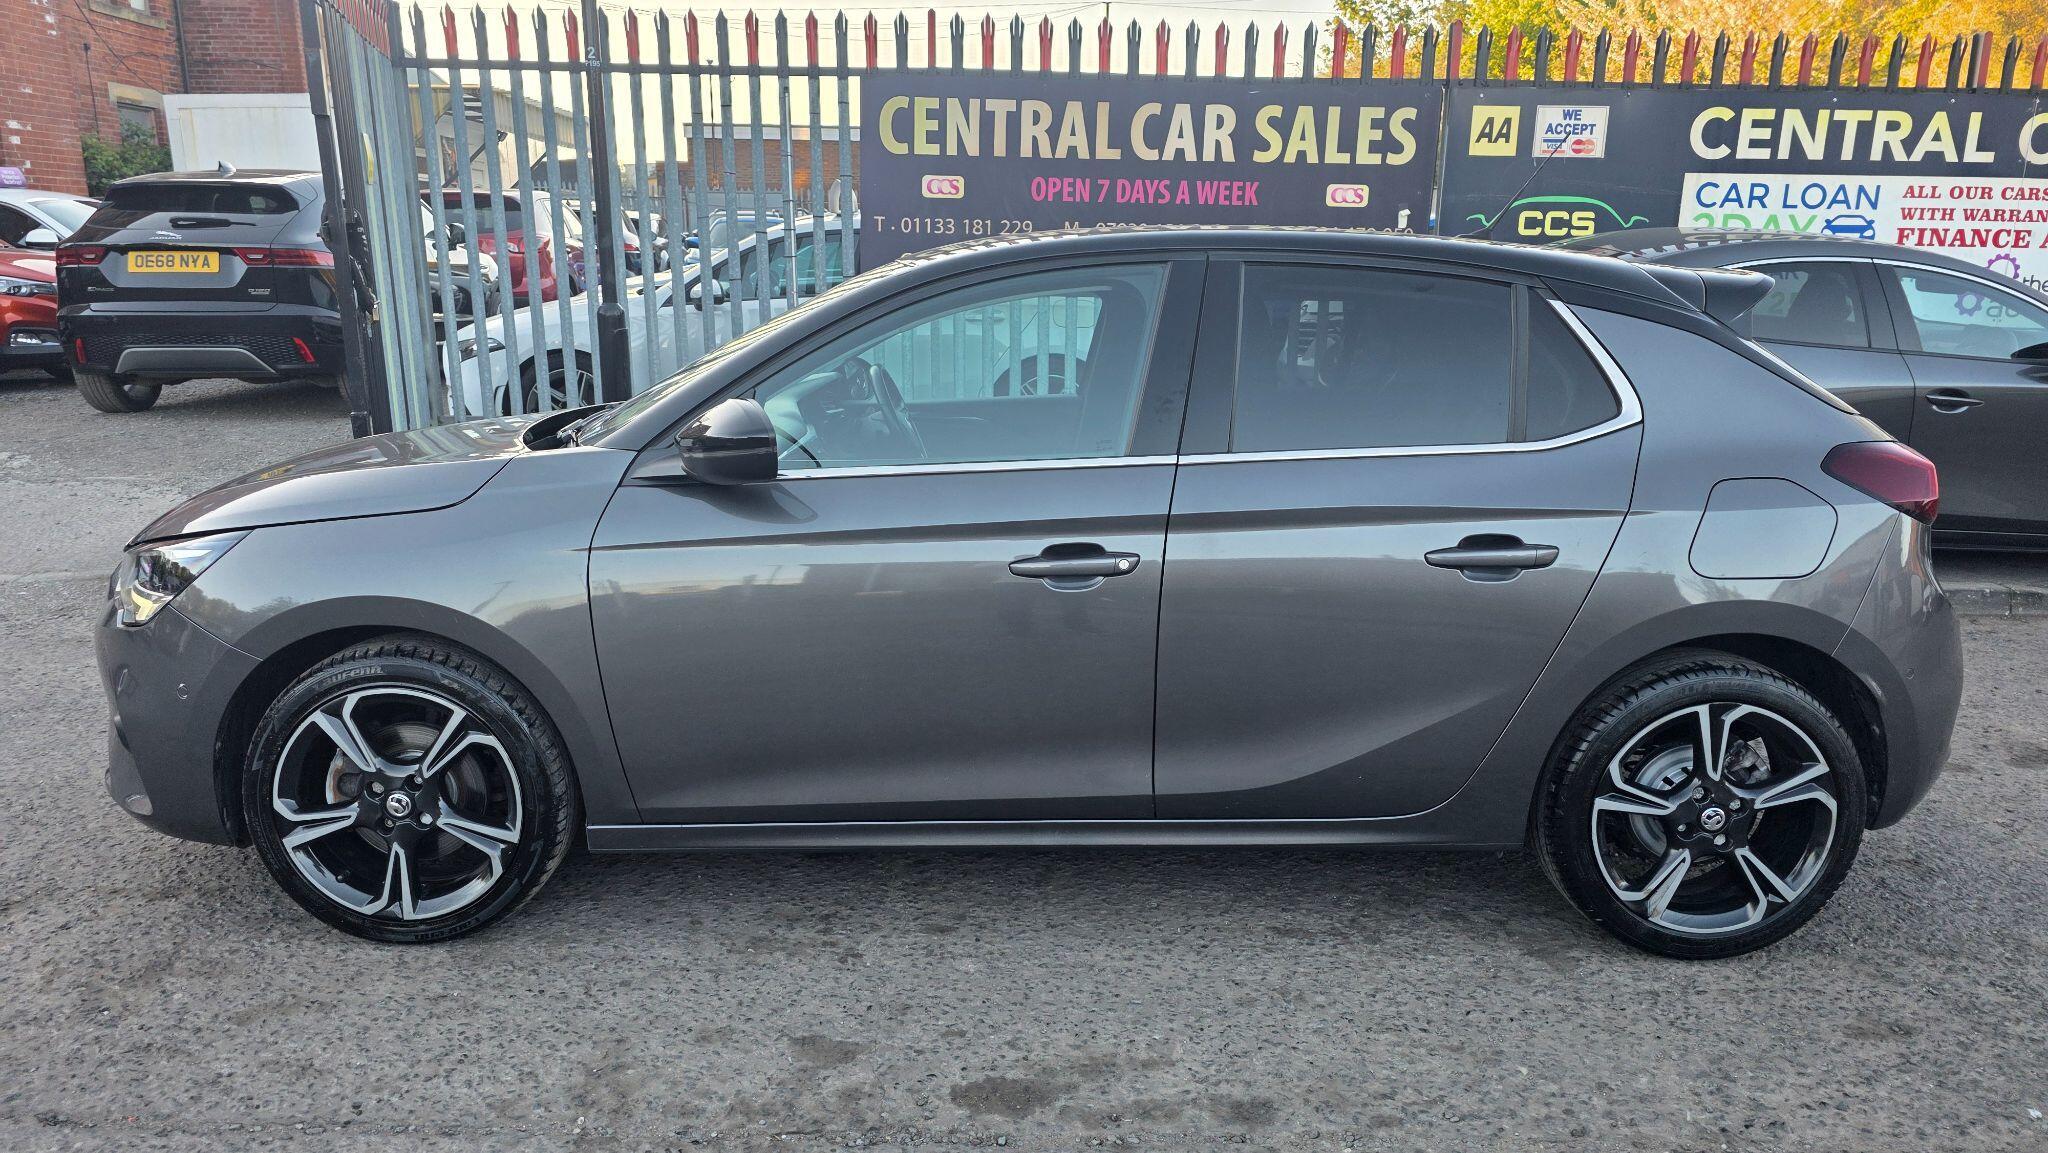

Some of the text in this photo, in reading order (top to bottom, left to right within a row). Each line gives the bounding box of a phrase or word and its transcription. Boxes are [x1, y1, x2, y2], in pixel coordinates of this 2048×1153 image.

[587, 46, 596, 59] 2
[1562, 109, 1582, 121] WE
[879, 95, 1418, 166] CENTRAL CAR SALES
[1474, 116, 1512, 144] AA
[1545, 123, 1596, 136] ACCEPT
[1690, 106, 1996, 162] CENTRAL
[927, 179, 960, 195] CCS
[1030, 176, 1260, 206] OPEN 7 DAYS A WEEK
[1902, 186, 1942, 198] ALL
[1949, 186, 1994, 200] OUR
[1331, 188, 1364, 204] CCS
[1696, 182, 1882, 210] CAR LOAN
[1900, 207, 1956, 221] WITH
[901, 217, 956, 234] 01133
[962, 219, 992, 236] 181
[1000, 220, 1033, 234] 229
[1518, 210, 1596, 237] CCS
[1896, 228, 2032, 248] FINANCE
[134, 254, 210, 268] OE68 NYA
